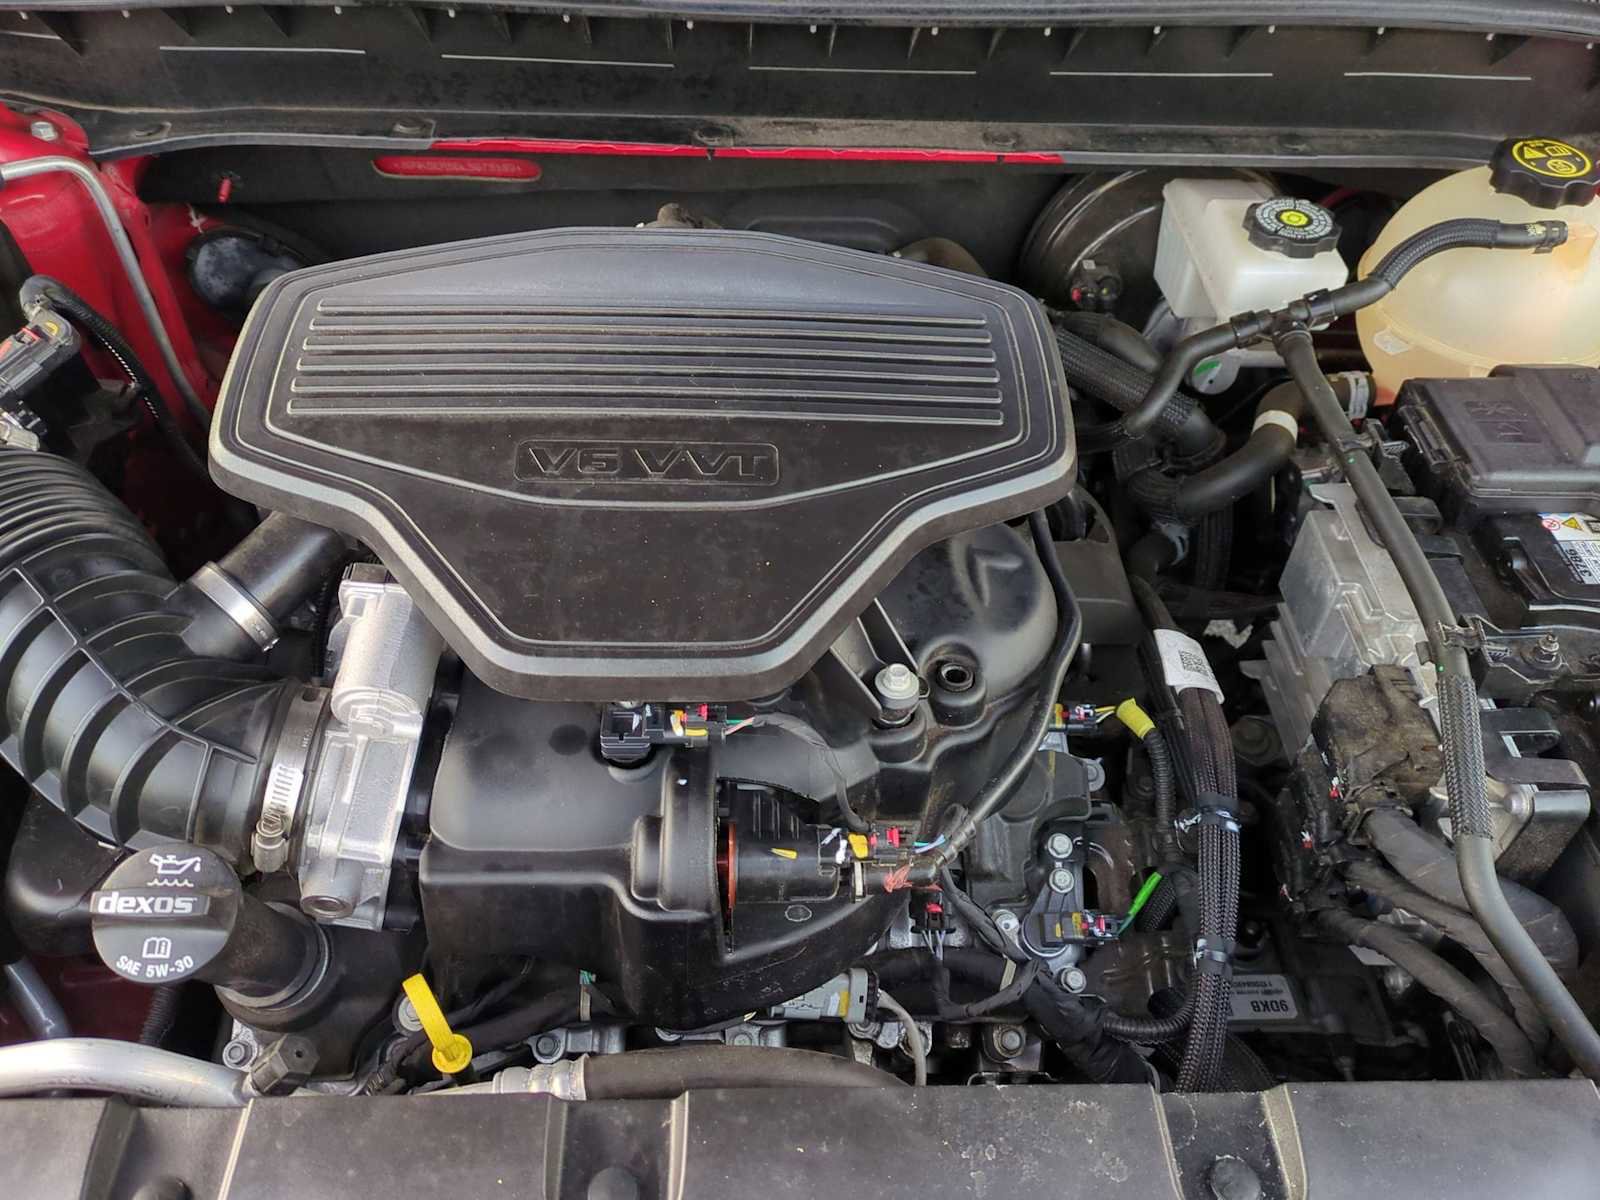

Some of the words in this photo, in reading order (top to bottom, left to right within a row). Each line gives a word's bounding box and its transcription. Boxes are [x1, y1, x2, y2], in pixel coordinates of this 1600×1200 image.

[528, 447, 622, 475] V6
[634, 448, 768, 476] VVT
[97, 891, 195, 914] dexos
[116, 955, 142, 976] SAE
[146, 955, 194, 978] 5W-30
